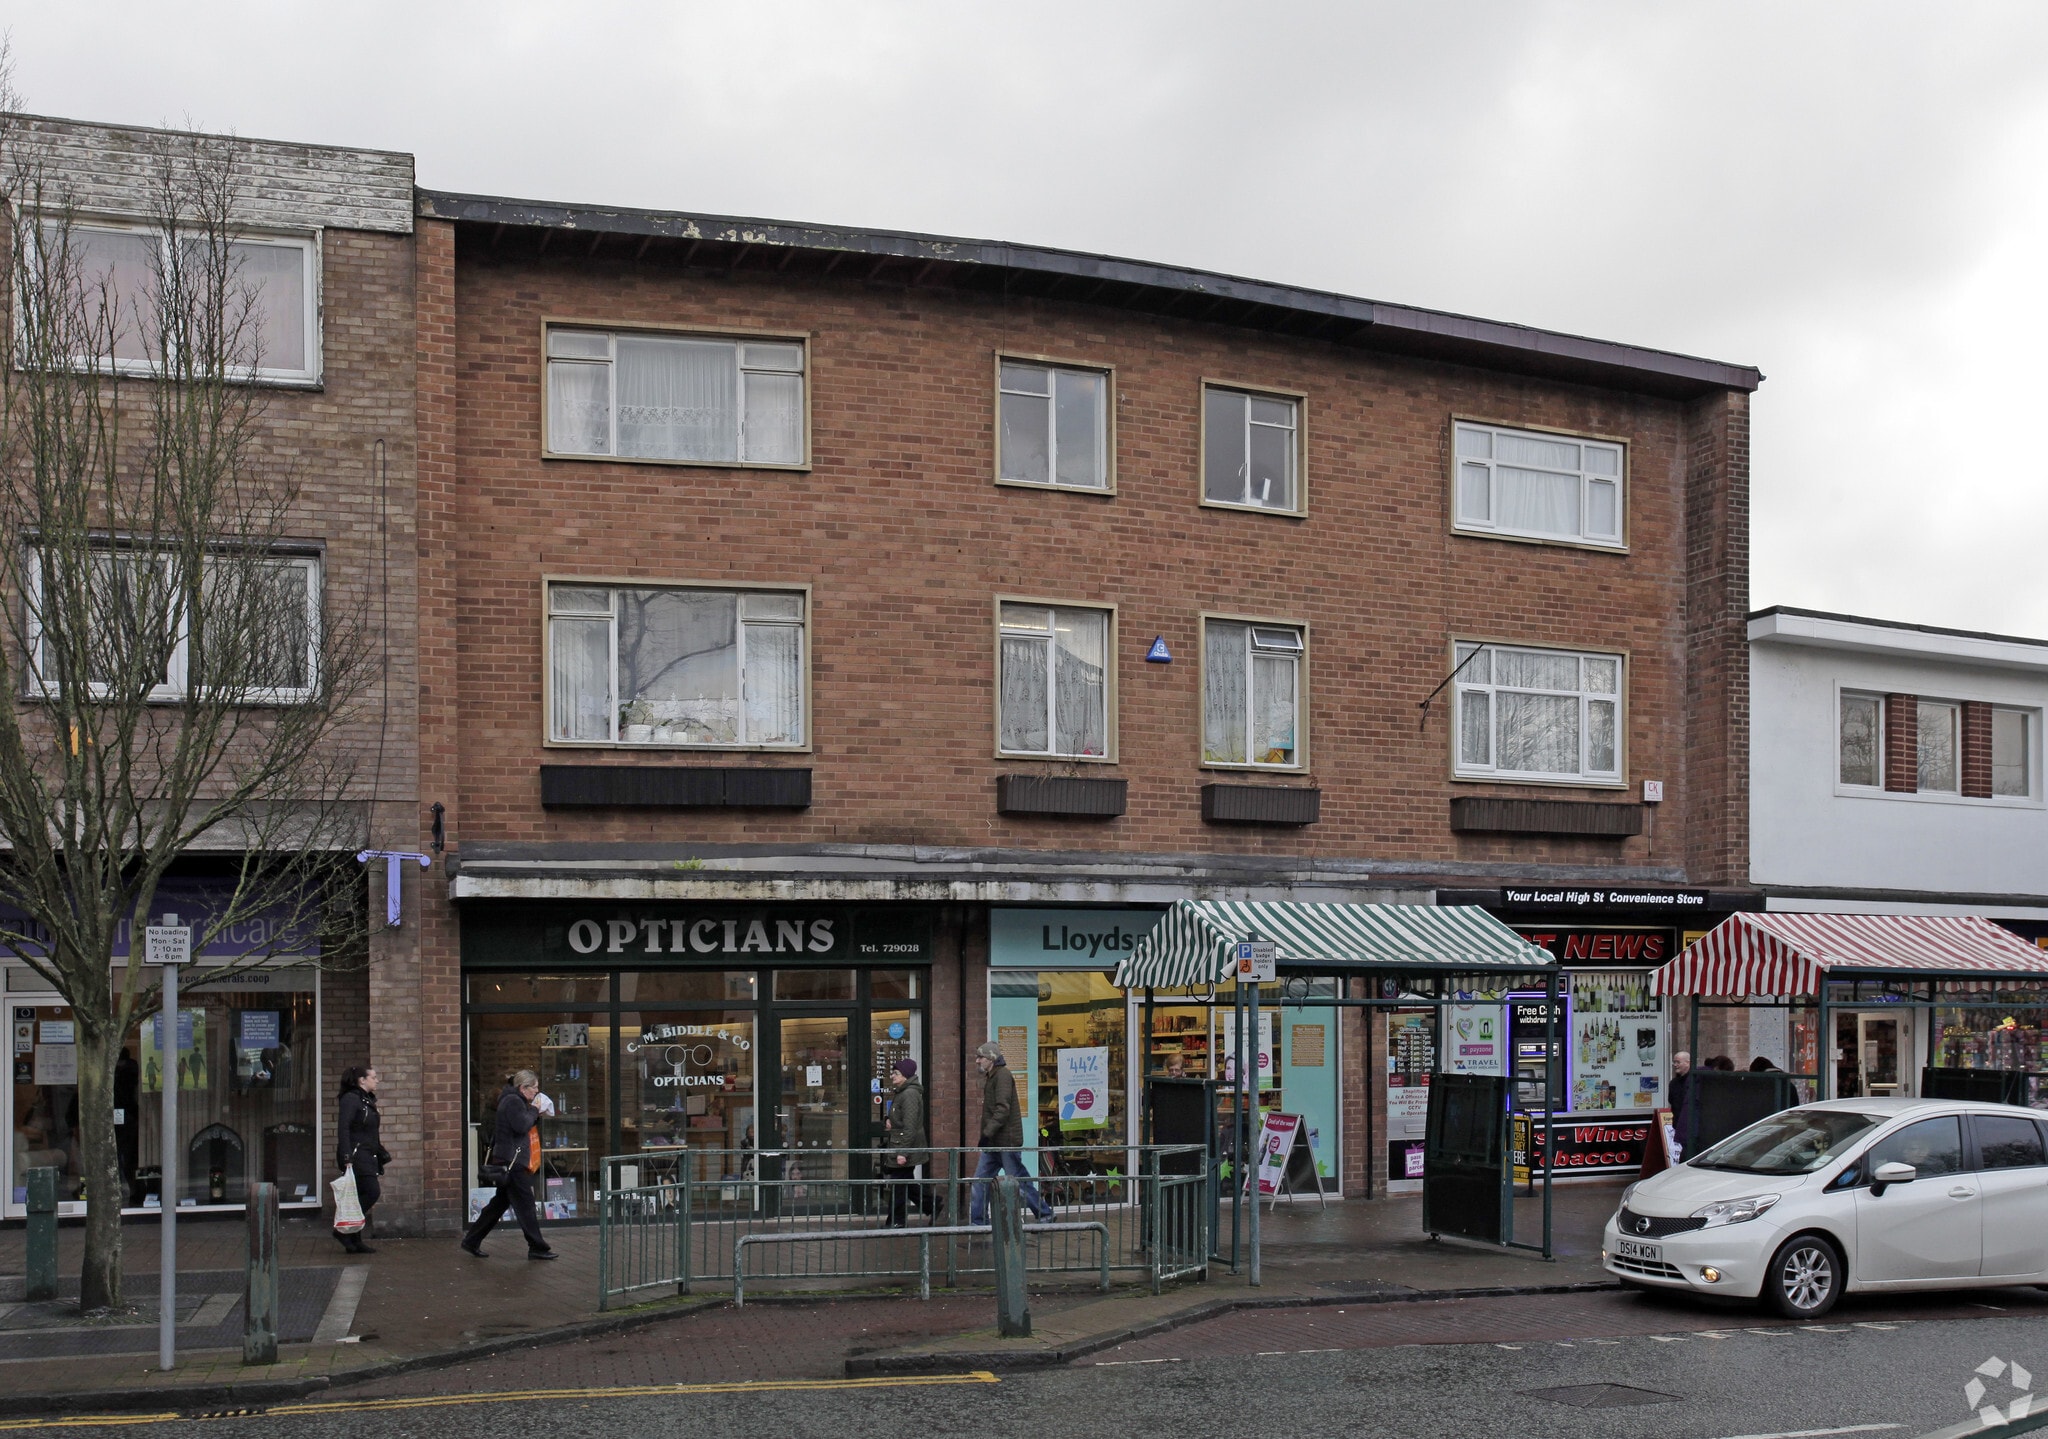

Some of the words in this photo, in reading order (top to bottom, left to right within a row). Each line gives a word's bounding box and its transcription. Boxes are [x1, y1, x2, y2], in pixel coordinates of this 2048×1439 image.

[1506, 891, 1531, 902] Your
[1534, 891, 1564, 902] Local
[1566, 892, 1590, 905] High
[1592, 892, 1605, 903] St
[1609, 892, 1674, 904] Convenience
[1676, 893, 1703, 905] Store
[568, 919, 835, 954] OPTICIANS
[860, 944, 879, 952] Tel.
[882, 944, 920, 952] 729028
[1241, 945, 1250, 957] P
[1564, 934, 1665, 960] NEWS
[1517, 1005, 1537, 1015] Free
[1539, 1005, 1561, 1015] Ch
[626, 1042, 641, 1053] C.
[642, 1033, 659, 1045] M.
[662, 1025, 714, 1039] BIDDLE
[717, 1029, 729, 1041] &
[732, 1034, 751, 1051] CO
[653, 1075, 724, 1087] OPTICIANS
[1574, 1126, 1648, 1144] Wines
[1513, 1150, 1526, 1165] ERE
[1409, 1164, 1424, 1172] parce
[1620, 1241, 1638, 1256] DS14
[1639, 1244, 1656, 1259] WGN
